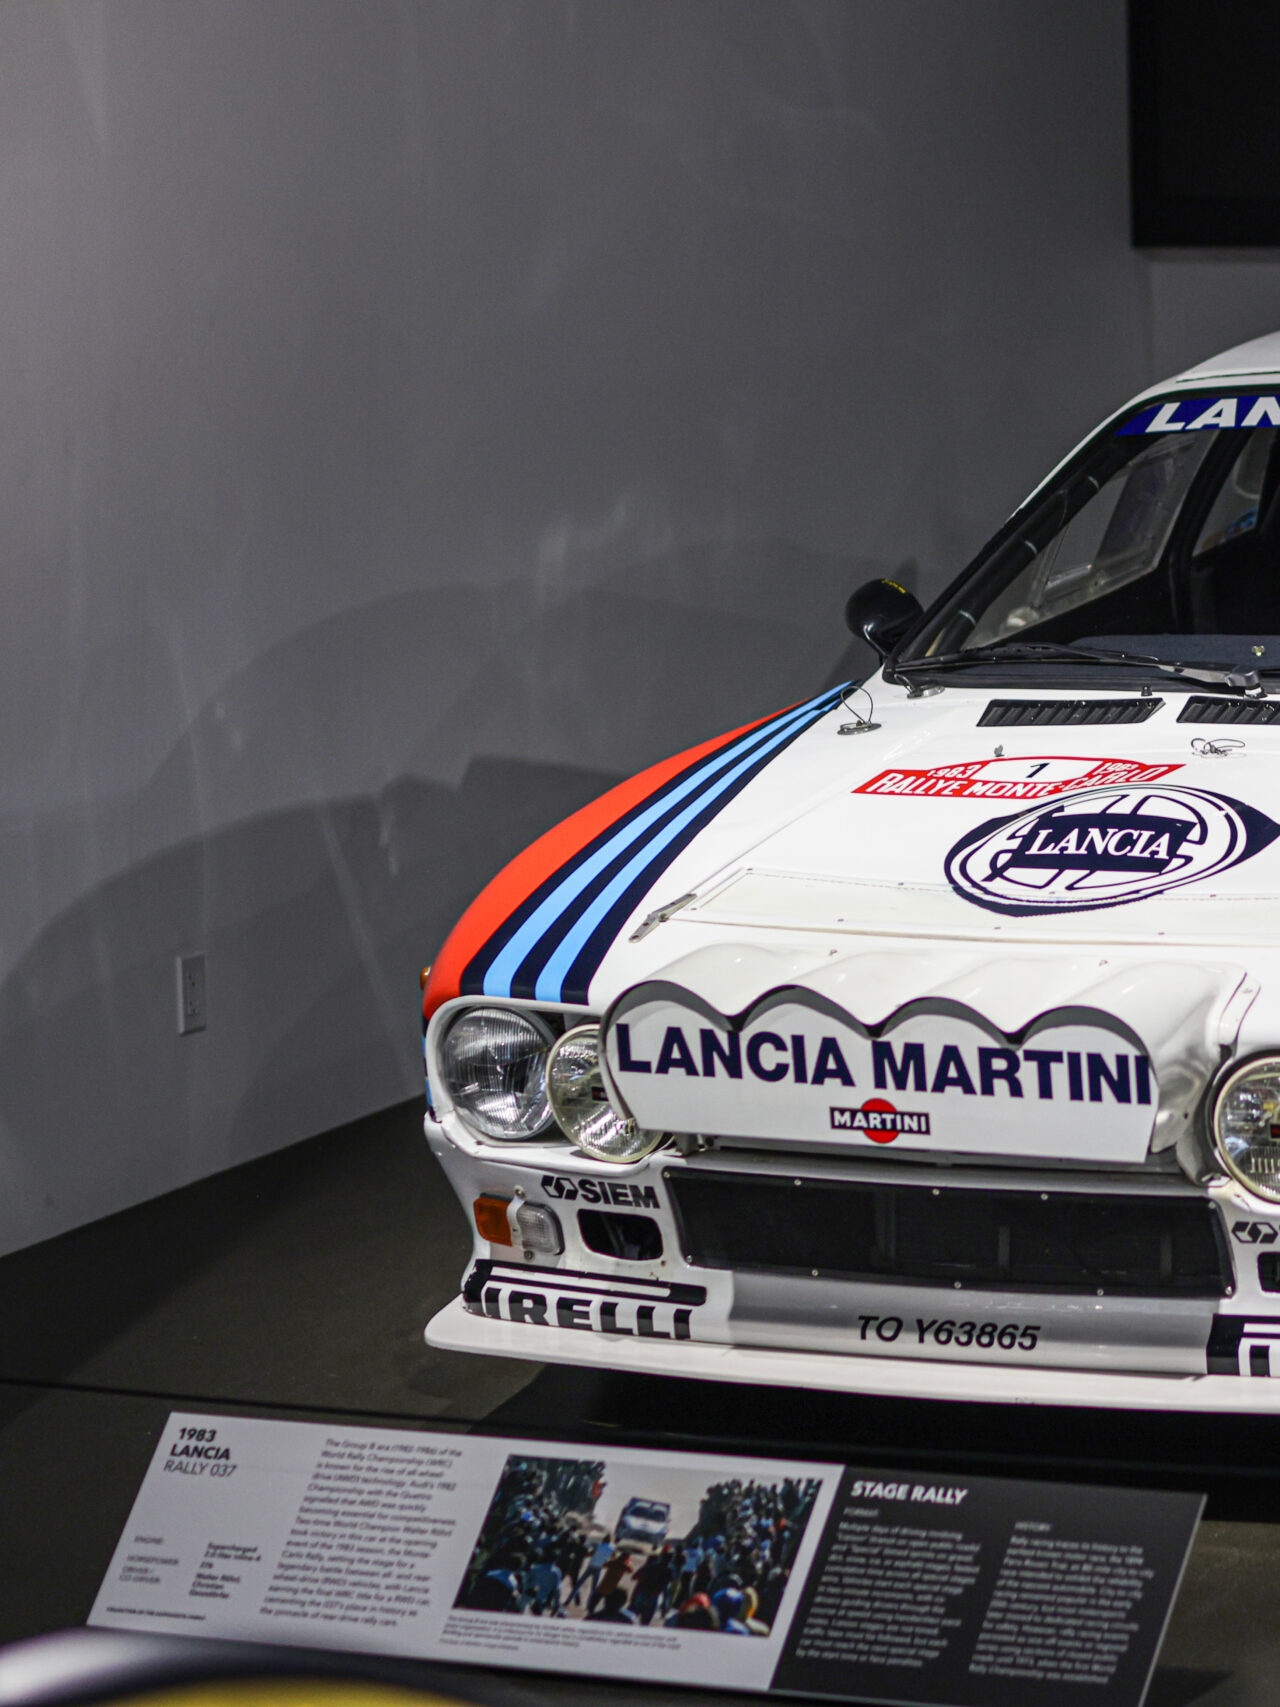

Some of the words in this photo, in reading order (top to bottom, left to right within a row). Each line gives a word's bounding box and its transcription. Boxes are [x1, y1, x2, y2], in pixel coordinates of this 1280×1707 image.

[866, 772, 967, 795] RALLYE
[970, 766, 1163, 797] MONTE-CARLO
[927, 763, 981, 780] 1983
[1024, 762, 1050, 779] 1
[1024, 827, 1171, 860] LANCIA
[615, 1022, 856, 1087] LANCIA
[871, 1038, 1152, 1106] MARTINI
[832, 1110, 928, 1133] MARTINI
[578, 1179, 661, 1209] SIEM
[857, 1315, 902, 1342] TO
[915, 1317, 1041, 1351] Y63865
[179, 1427, 217, 1443] 1983
[170, 1443, 230, 1461] LANCIA
[163, 1459, 208, 1475] RALLY
[210, 1463, 237, 1477] 037
[850, 1480, 910, 1500] STAGE
[911, 1485, 968, 1505] RALLY
